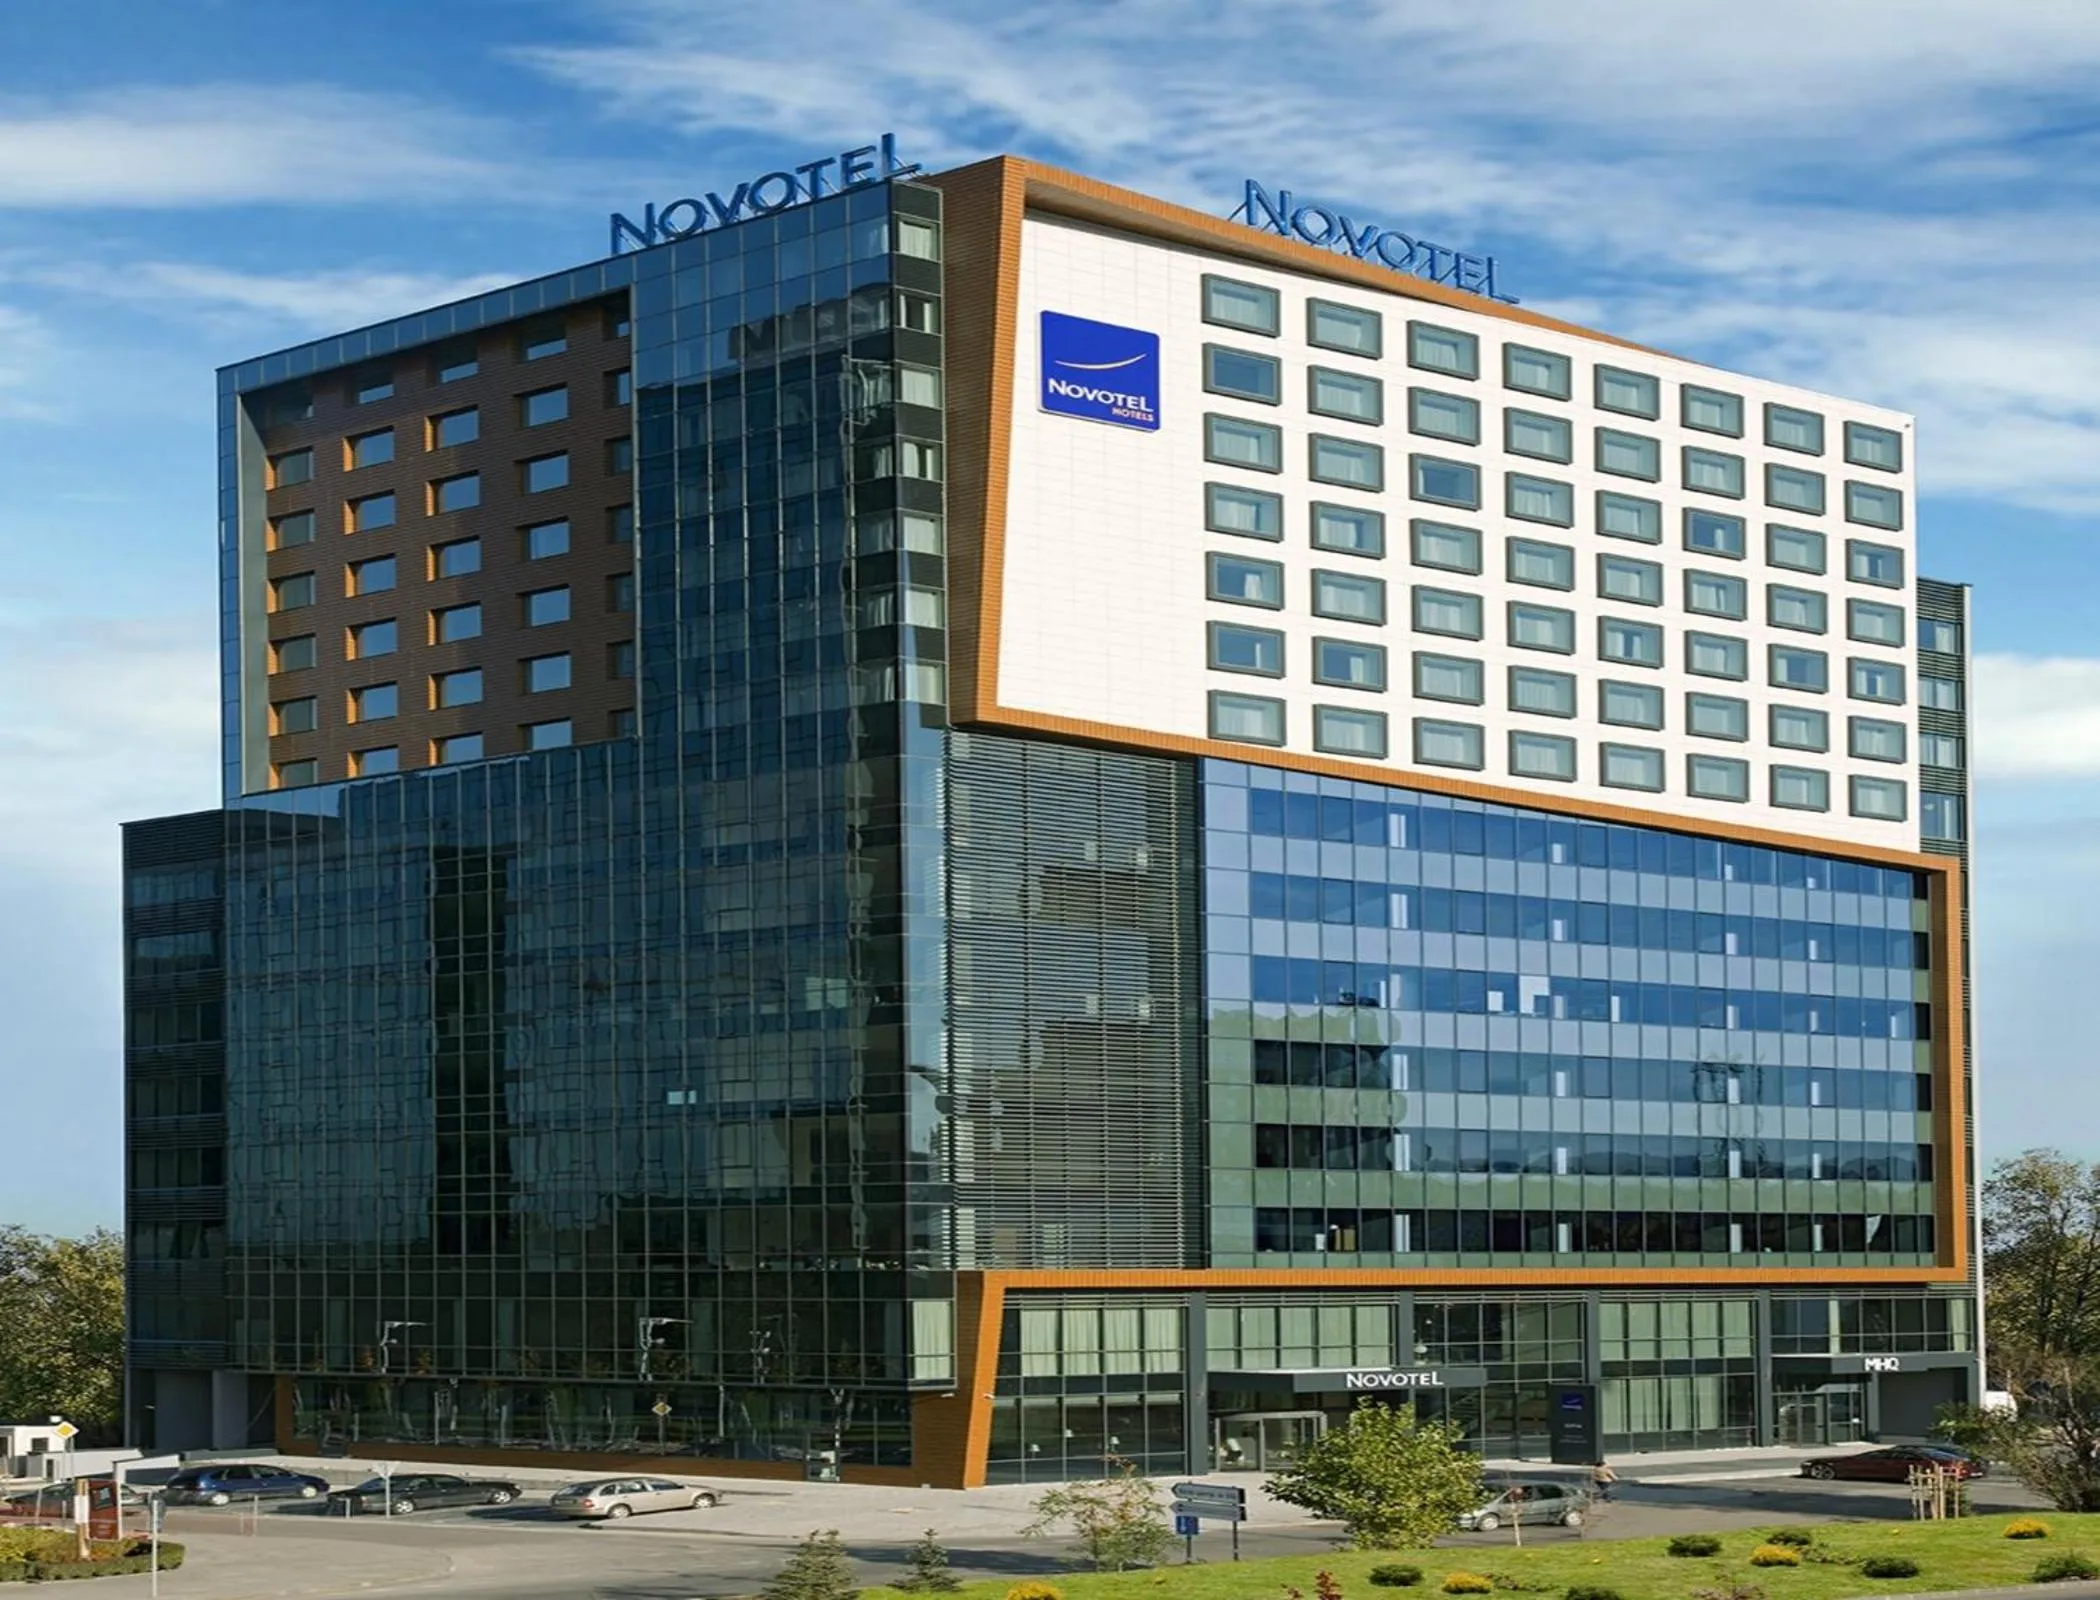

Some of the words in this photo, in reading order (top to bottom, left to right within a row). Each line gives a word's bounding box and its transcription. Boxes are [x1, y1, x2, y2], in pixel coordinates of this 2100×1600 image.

[611, 133, 922, 254] NOVOTEL
[1245, 179, 1520, 304] NOVOTEL
[1048, 378, 1154, 412] NOVOTEL
[1111, 407, 1154, 422] HOTELS
[1864, 1357, 1899, 1371] MHQ
[1346, 1371, 1444, 1388] NOVOTEL
